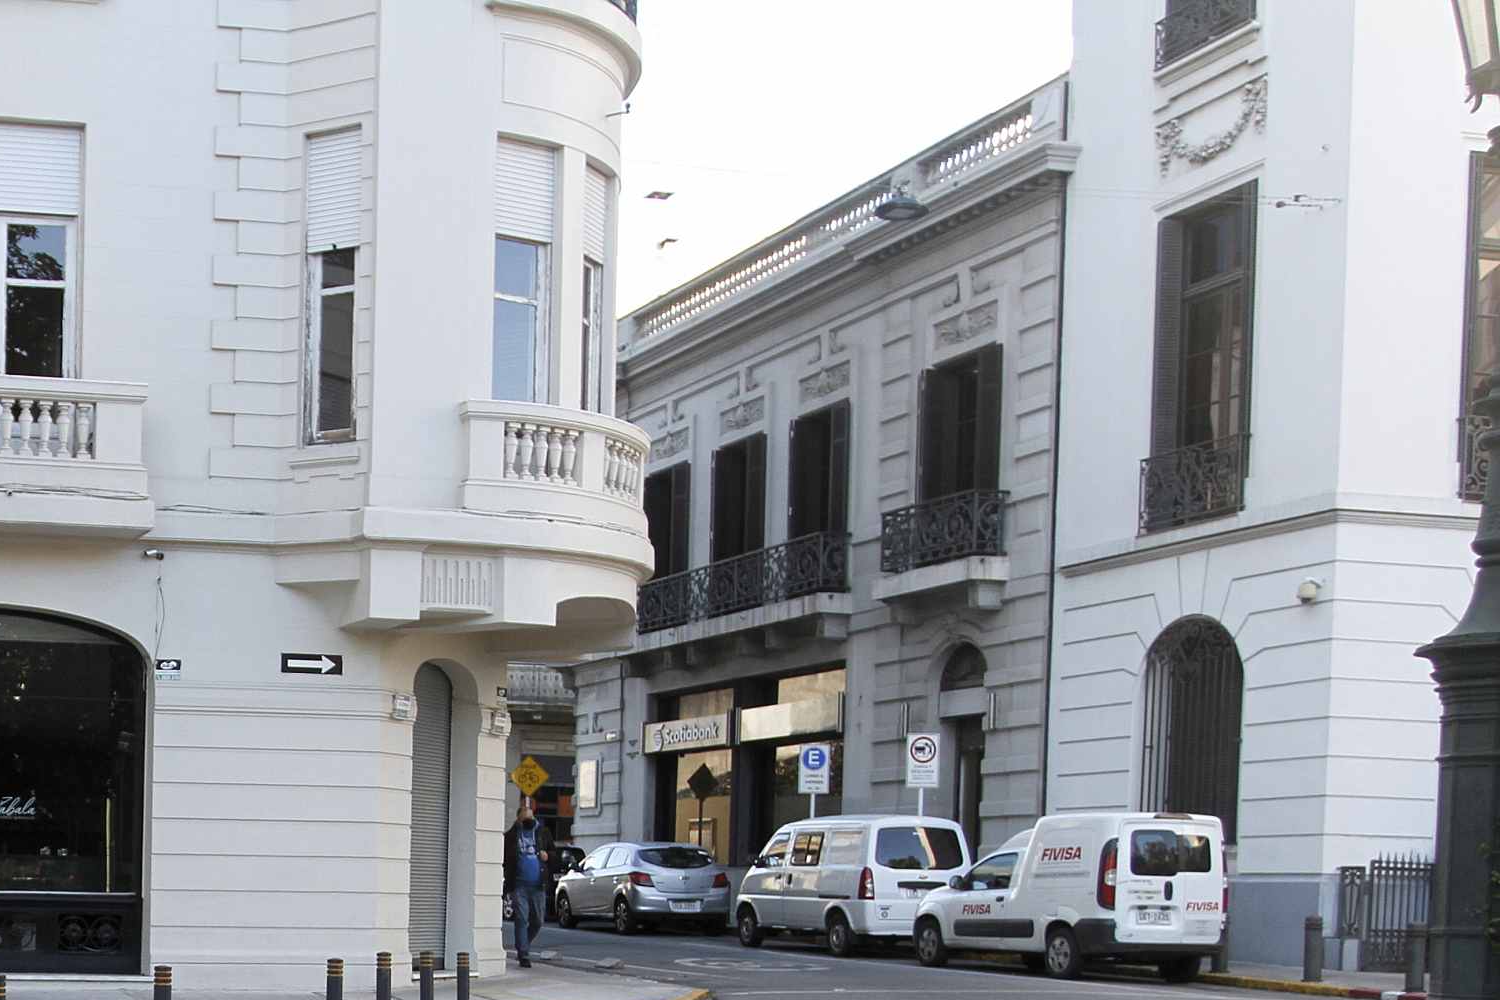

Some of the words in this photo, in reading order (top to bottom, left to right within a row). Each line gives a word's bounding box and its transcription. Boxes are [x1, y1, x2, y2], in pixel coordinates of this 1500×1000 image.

[664, 722, 719, 744] Scotiabank
[808, 750, 820, 765] E
[1041, 846, 1082, 861] FIVISA
[961, 904, 992, 915] FIVISA
[1185, 901, 1219, 911] FIVISA
